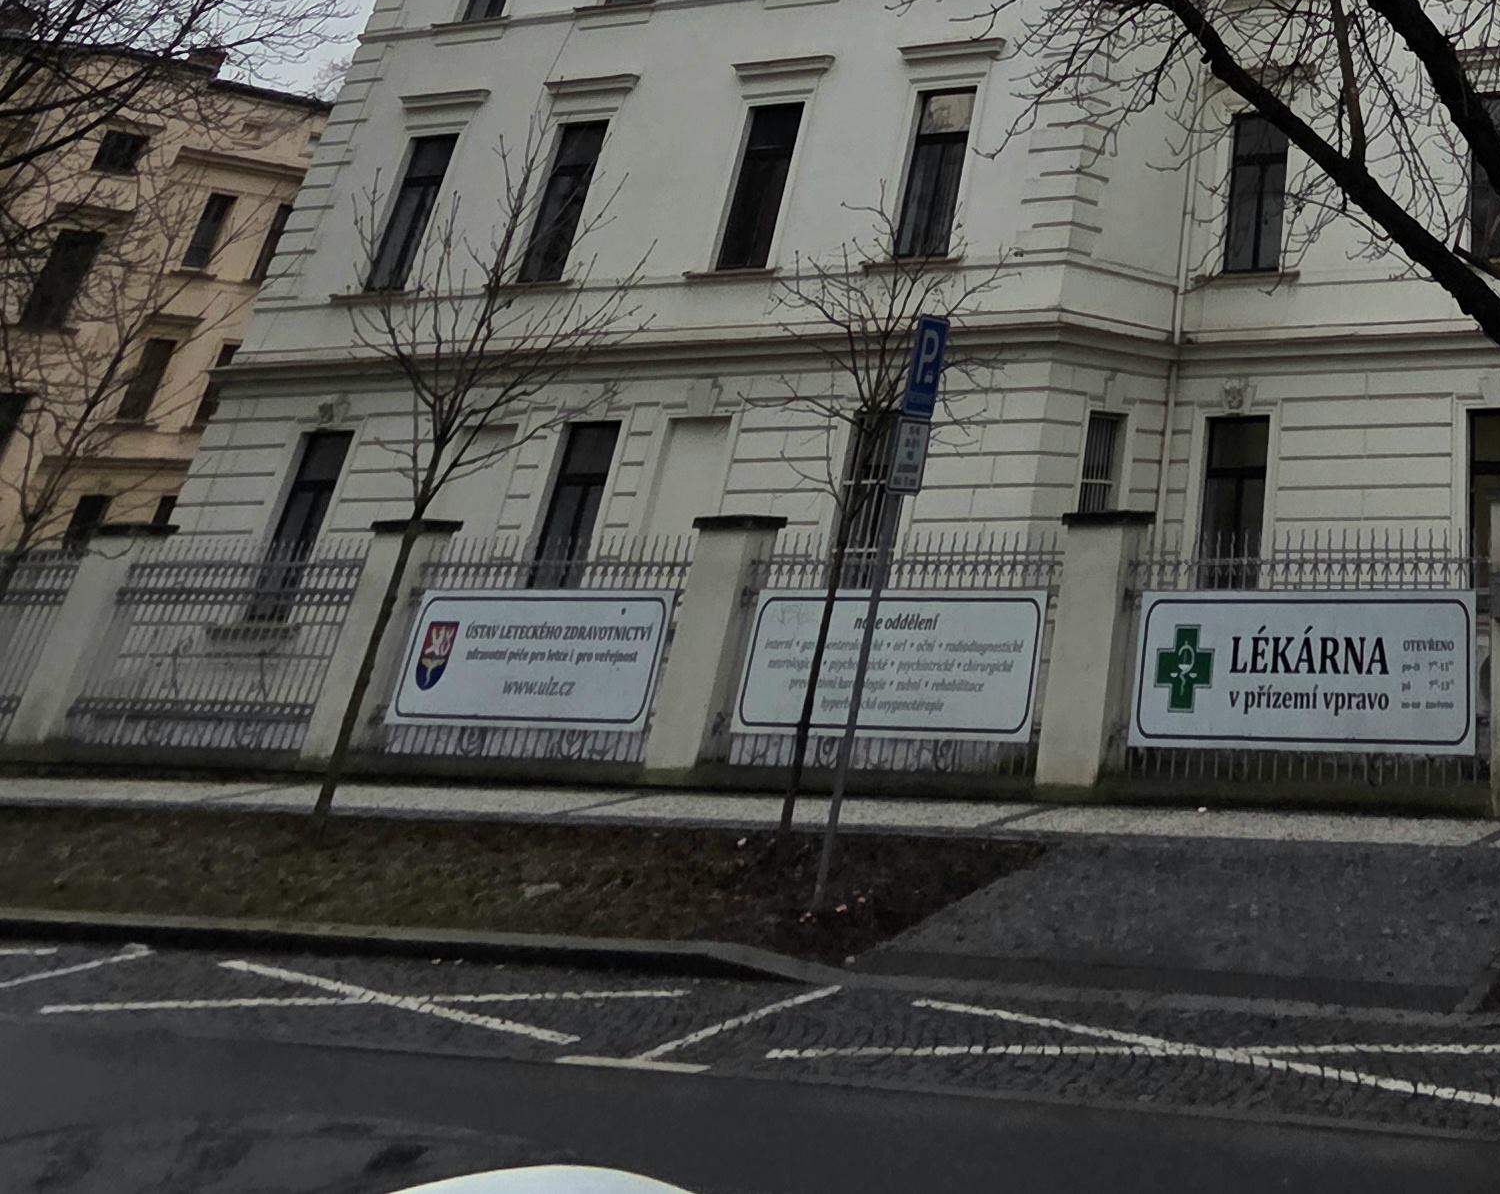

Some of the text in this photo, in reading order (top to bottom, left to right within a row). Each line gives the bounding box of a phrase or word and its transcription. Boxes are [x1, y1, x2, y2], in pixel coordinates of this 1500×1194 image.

[884, 613, 940, 630] oddělení
[465, 622, 654, 642] ÚSTAV LETECKÉHO ZDRAVOTNICTVÍ
[1229, 625, 1389, 675] LÉKÁRNA
[1403, 638, 1455, 652] OTEVŘENO
[466, 647, 508, 661] zdravotní
[507, 649, 528, 664] péče
[528, 651, 546, 664] pro
[575, 651, 593, 665] pro
[595, 650, 638, 665] veřejnost
[502, 676, 576, 696] www.ulz.cz
[1229, 684, 1389, 716] v přízemí vpravo
